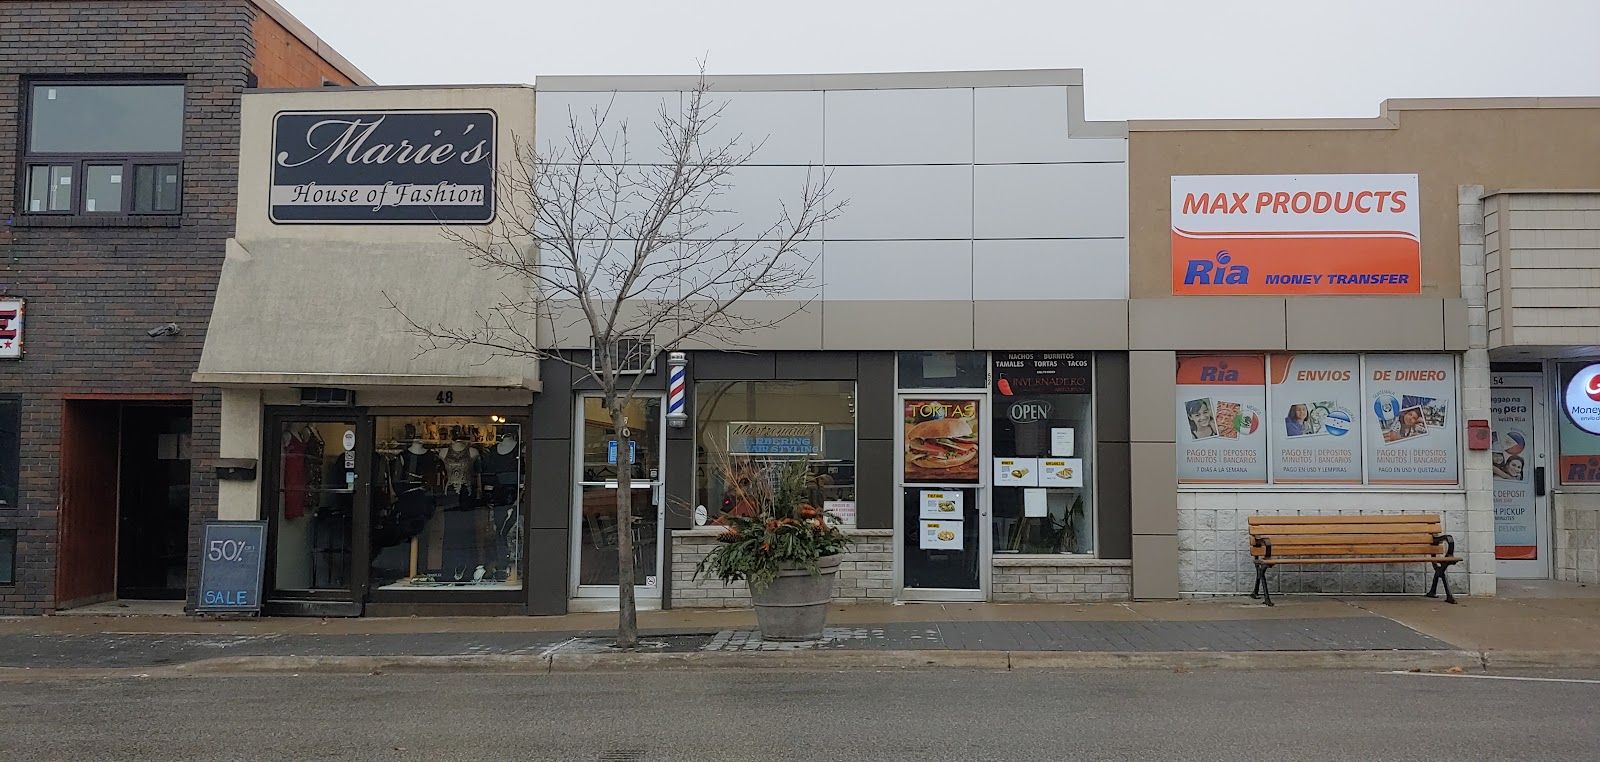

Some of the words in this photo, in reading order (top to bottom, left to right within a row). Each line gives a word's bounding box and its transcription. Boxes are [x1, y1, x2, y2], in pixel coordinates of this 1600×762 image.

[277, 114, 490, 167] Marie's
[291, 182, 359, 204] House
[366, 181, 394, 212] of
[394, 181, 484, 207] Fashion
[1182, 192, 1250, 214] MAX
[1255, 191, 1407, 214] PRODUCTS
[1183, 250, 1249, 285] Ria
[1265, 274, 1322, 285] MONEY
[1327, 273, 1409, 285] TRANSFER
[1200, 361, 1239, 382] Ria
[1296, 370, 1351, 381] ENVIOS
[1373, 370, 1391, 381] DE
[1395, 370, 1446, 381] DINERO
[1493, 377, 1504, 385] 54
[436, 391, 453, 404] 48
[909, 404, 977, 419] TORTAS
[1012, 404, 1047, 420] OPEN
[1504, 406, 1526, 415] pera
[1498, 490, 1525, 498] DEPOSIT
[208, 540, 246, 562] 50%
[205, 590, 247, 605] SALE
